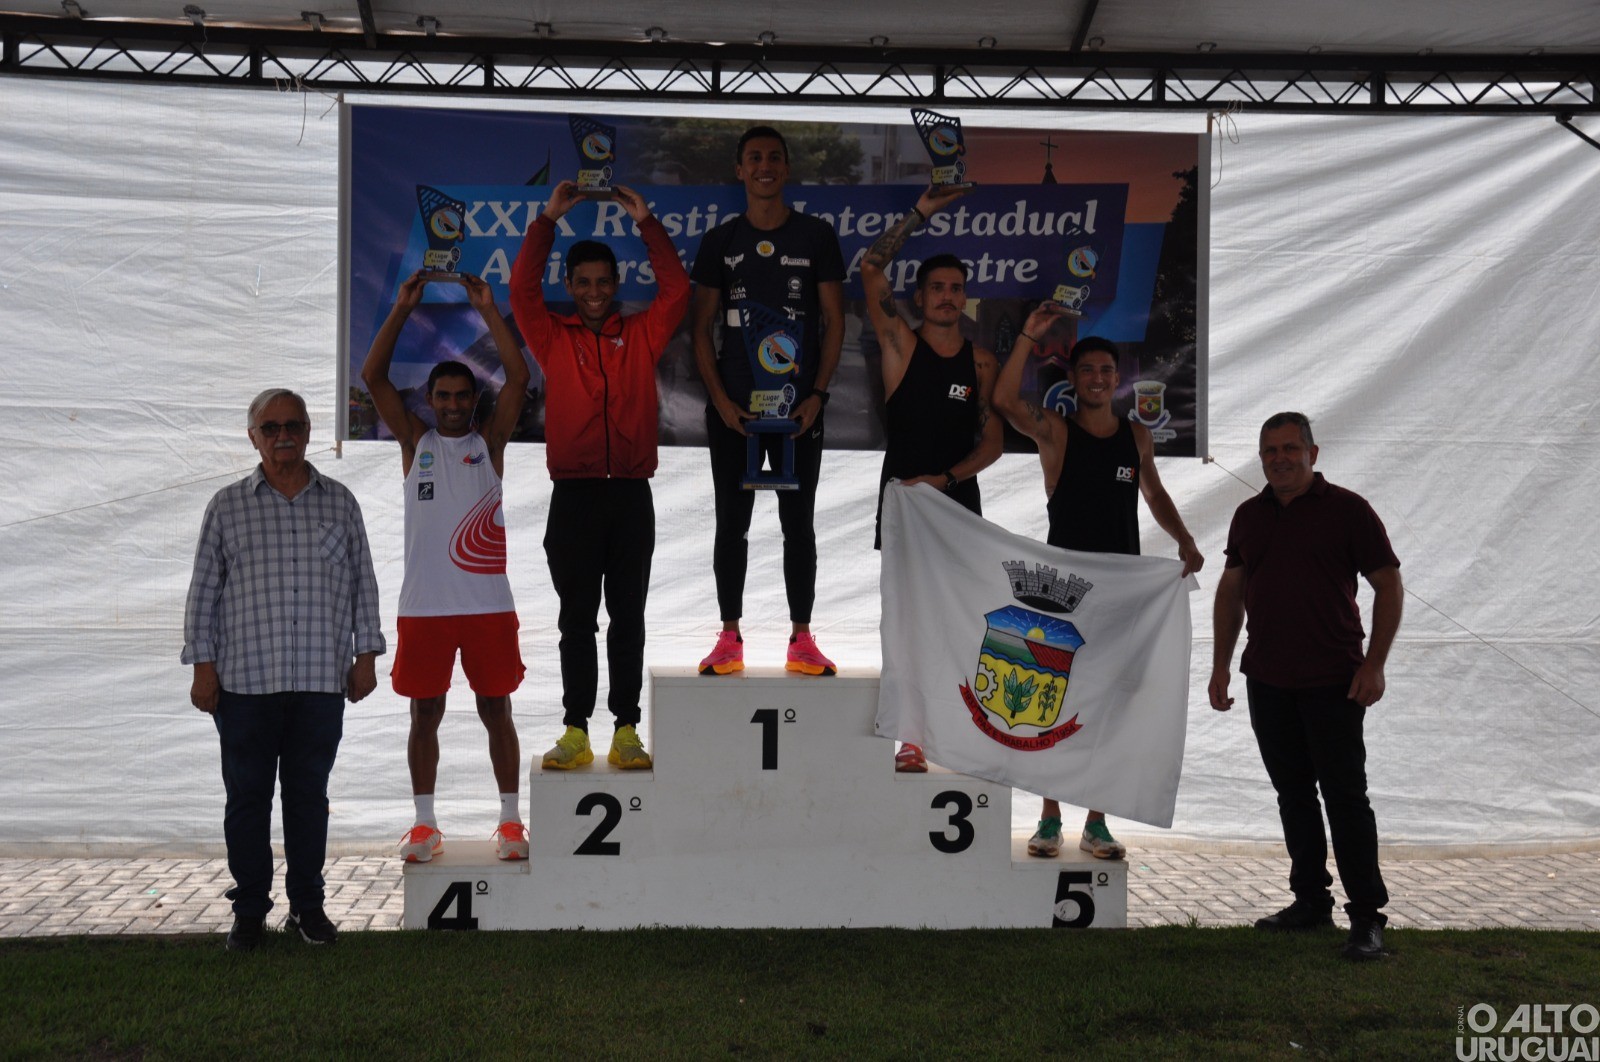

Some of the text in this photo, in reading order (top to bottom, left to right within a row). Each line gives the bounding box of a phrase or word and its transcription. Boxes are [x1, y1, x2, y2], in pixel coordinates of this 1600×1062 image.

[591, 200, 743, 238] Rsti
[842, 247, 1039, 292] Aptre
[762, 394, 780, 402] Lugar
[977, 715, 992, 734] PAZ
[1000, 734, 1051, 749] TRABALHO
[1054, 725, 1076, 740] 1954
